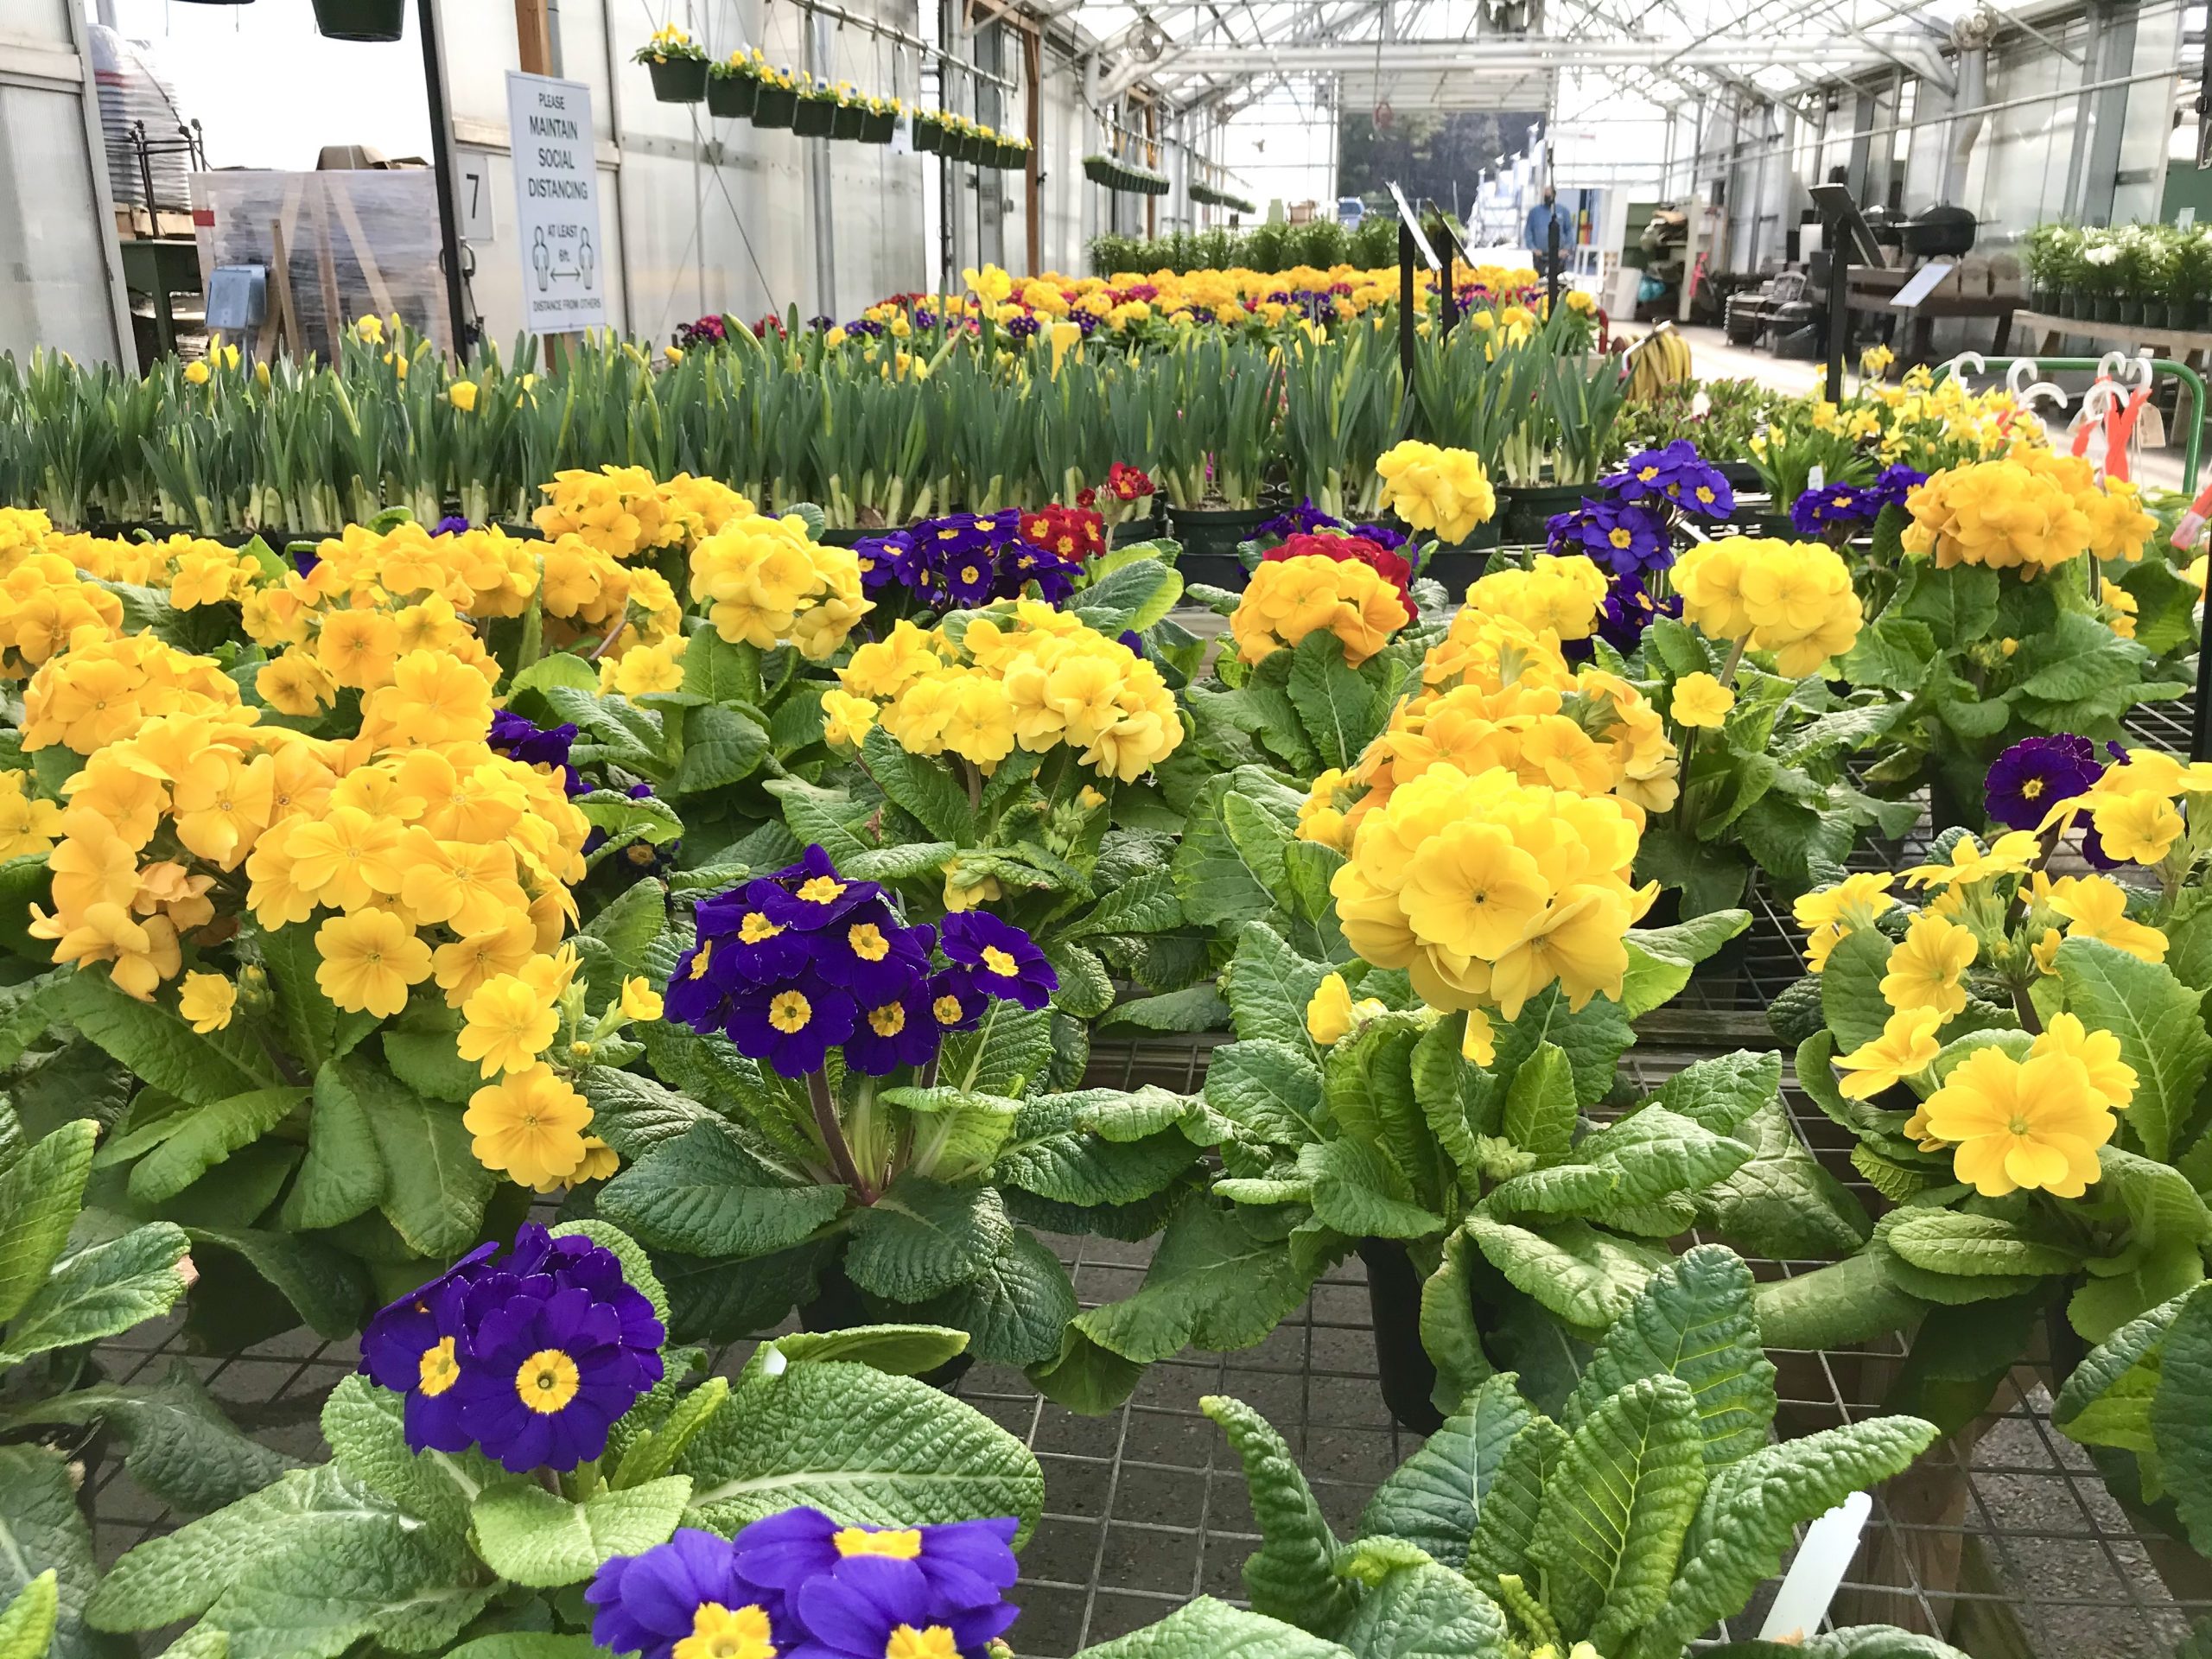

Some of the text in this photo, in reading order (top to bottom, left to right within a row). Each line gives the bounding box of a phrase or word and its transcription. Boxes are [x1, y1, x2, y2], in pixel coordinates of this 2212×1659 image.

[538, 92, 565, 110] PLEASE
[530, 115, 578, 140] MAINTAIN
[538, 148, 575, 169] SOCIAL
[467, 174, 479, 219] 7
[528, 177, 588, 200] DISTANCING
[548, 224, 578, 238] AT LEAST
[533, 297, 601, 312] DISTANCE FROM OTHERS
